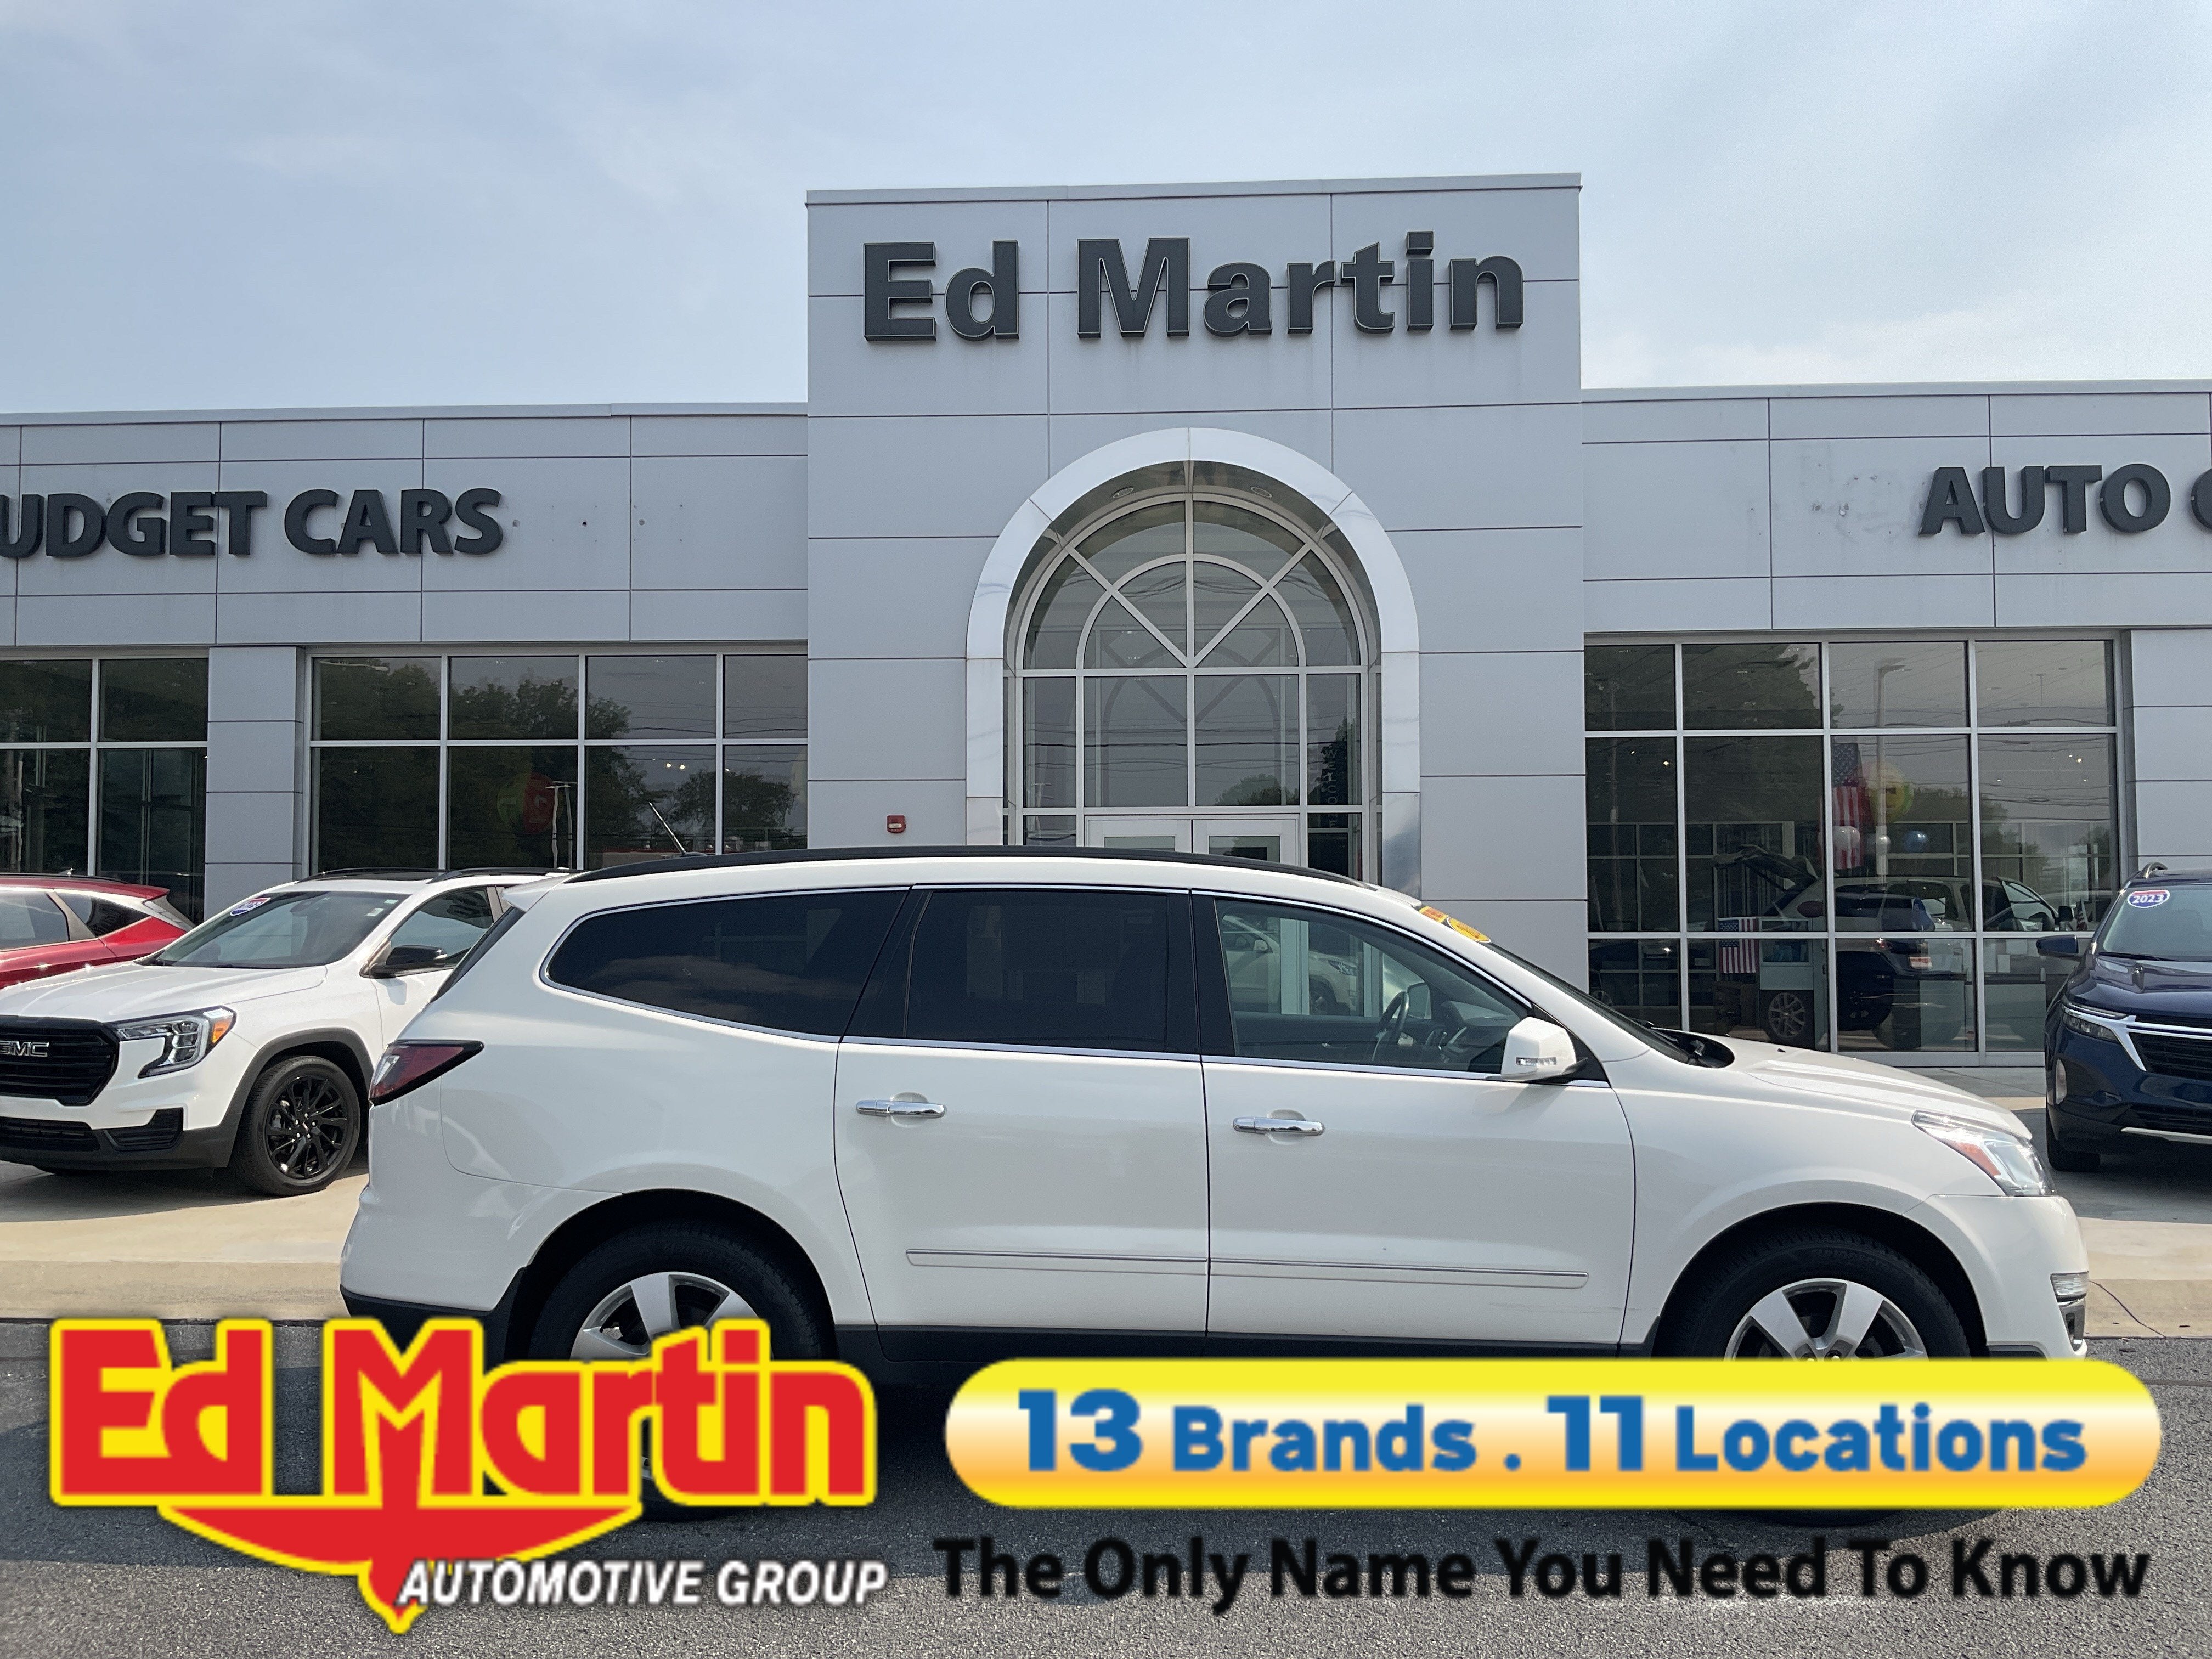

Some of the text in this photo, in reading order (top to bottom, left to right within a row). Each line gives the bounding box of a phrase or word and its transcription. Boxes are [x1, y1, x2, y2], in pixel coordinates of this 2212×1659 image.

[863, 230, 1524, 342] Ed Martin
[284, 488, 504, 555] CARS
[1918, 464, 2171, 536] AUTO
[2132, 894, 2164, 904] 2023
